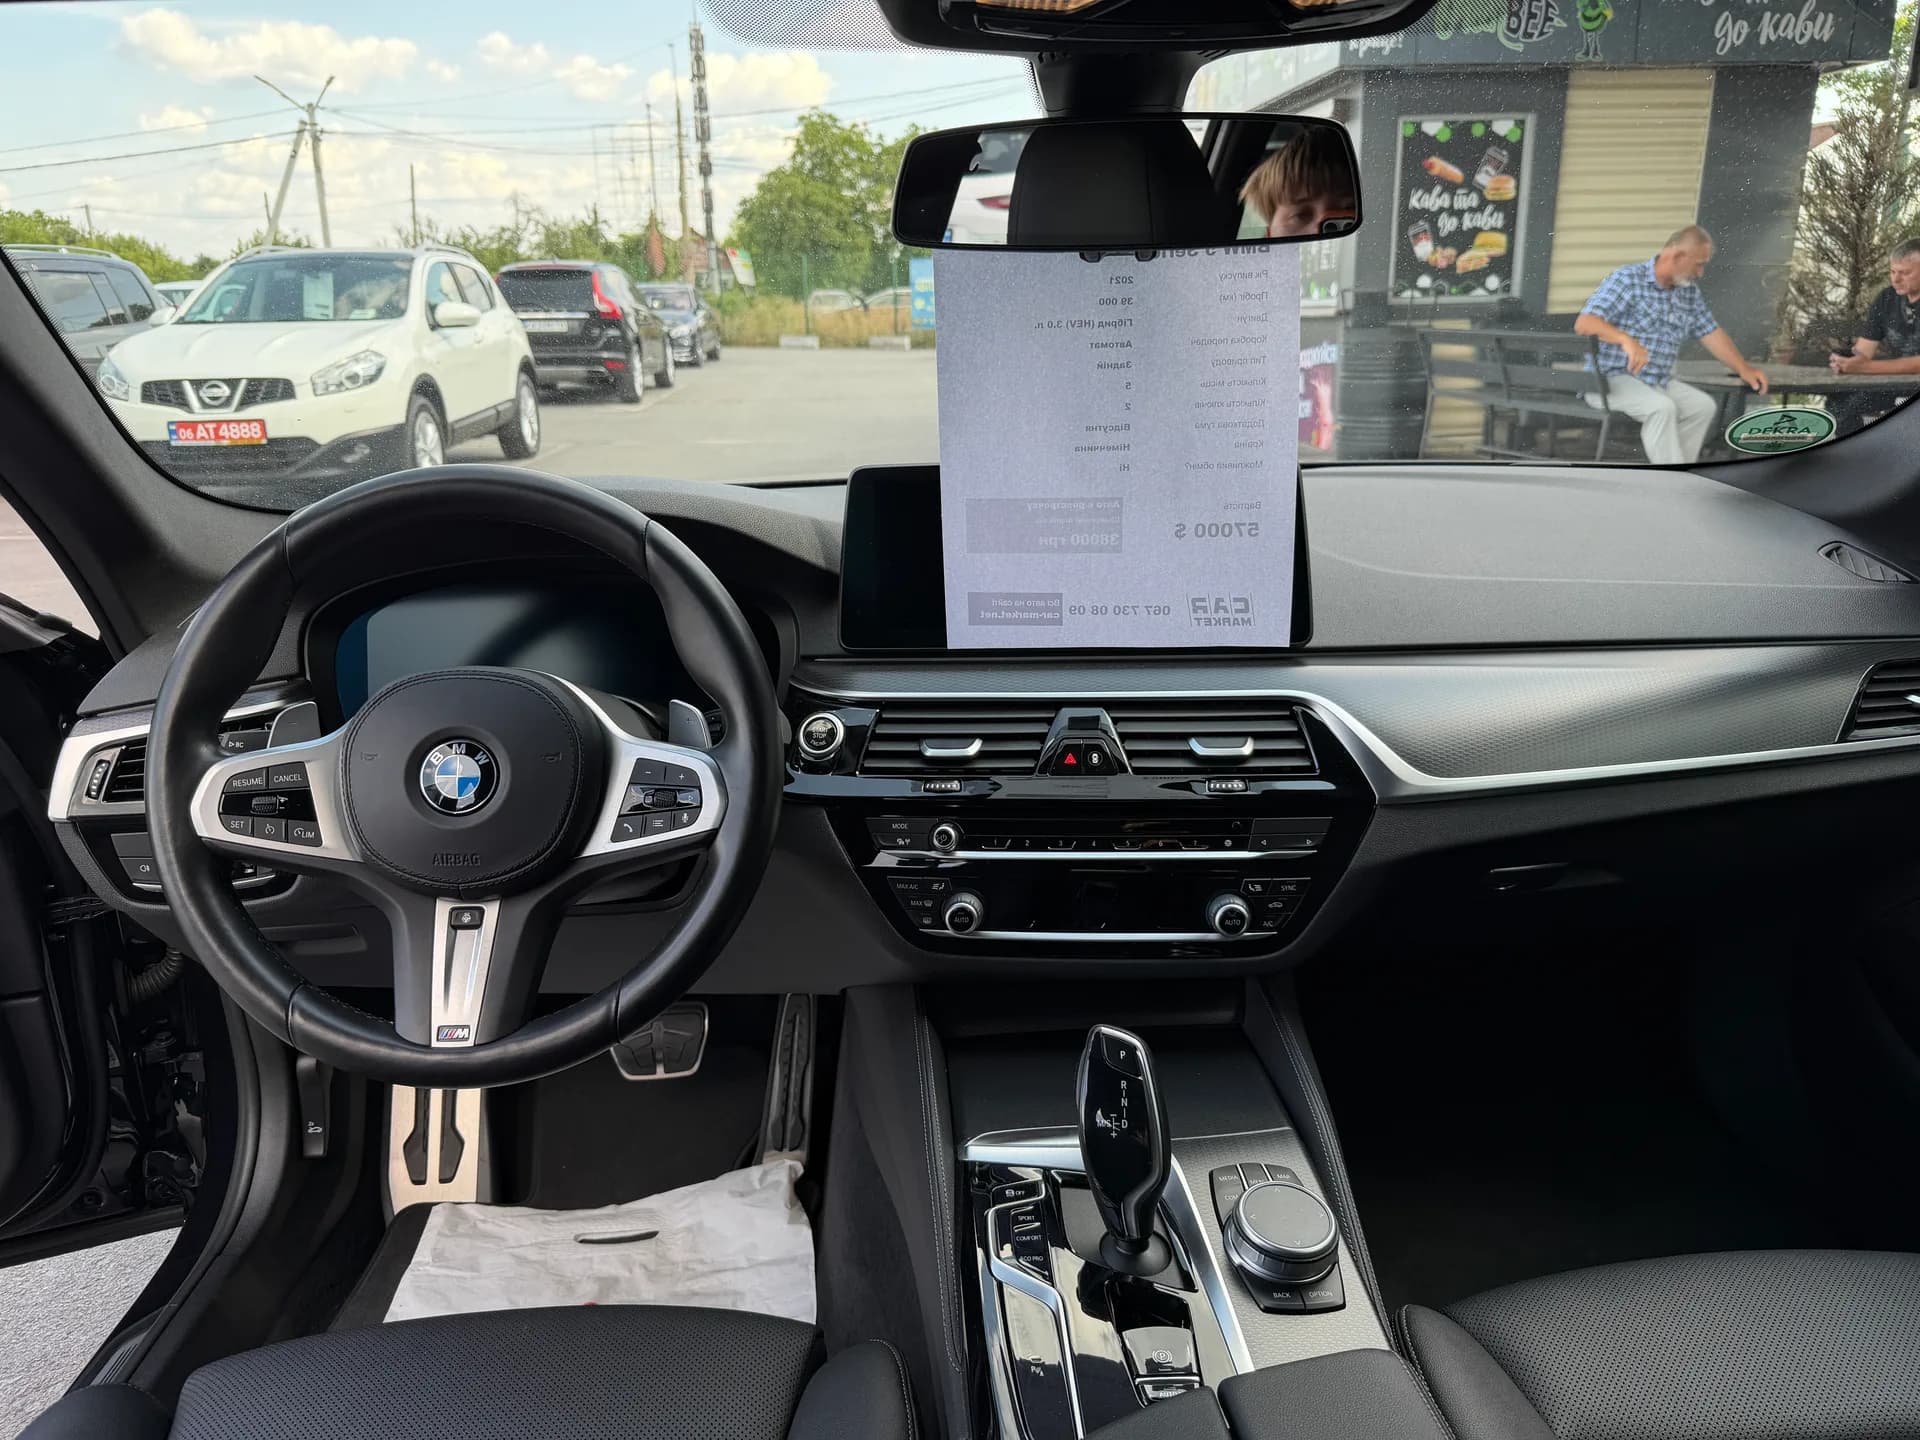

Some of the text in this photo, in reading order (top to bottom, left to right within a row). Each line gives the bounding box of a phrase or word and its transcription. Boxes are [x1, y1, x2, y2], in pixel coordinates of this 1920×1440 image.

[1714, 0, 1835, 55] до кави
[1408, 183, 1452, 212] Кава
[1437, 204, 1505, 237] до кави
[179, 428, 194, 440] 06
[218, 421, 262, 440] 4888
[1748, 426, 1811, 435] DEKRA
[429, 743, 490, 766] BMW
[232, 773, 303, 788] RESUME CANCEL
[230, 820, 245, 829] SET
[301, 831, 315, 839] LIM
[432, 852, 480, 867] AIRBAG
[1262, 920, 1274, 928] A/C
[1120, 1050, 1126, 1060] P
[1120, 1080, 1127, 1089] R
[1121, 1098, 1128, 1107] N
[1121, 1119, 1128, 1129] D
